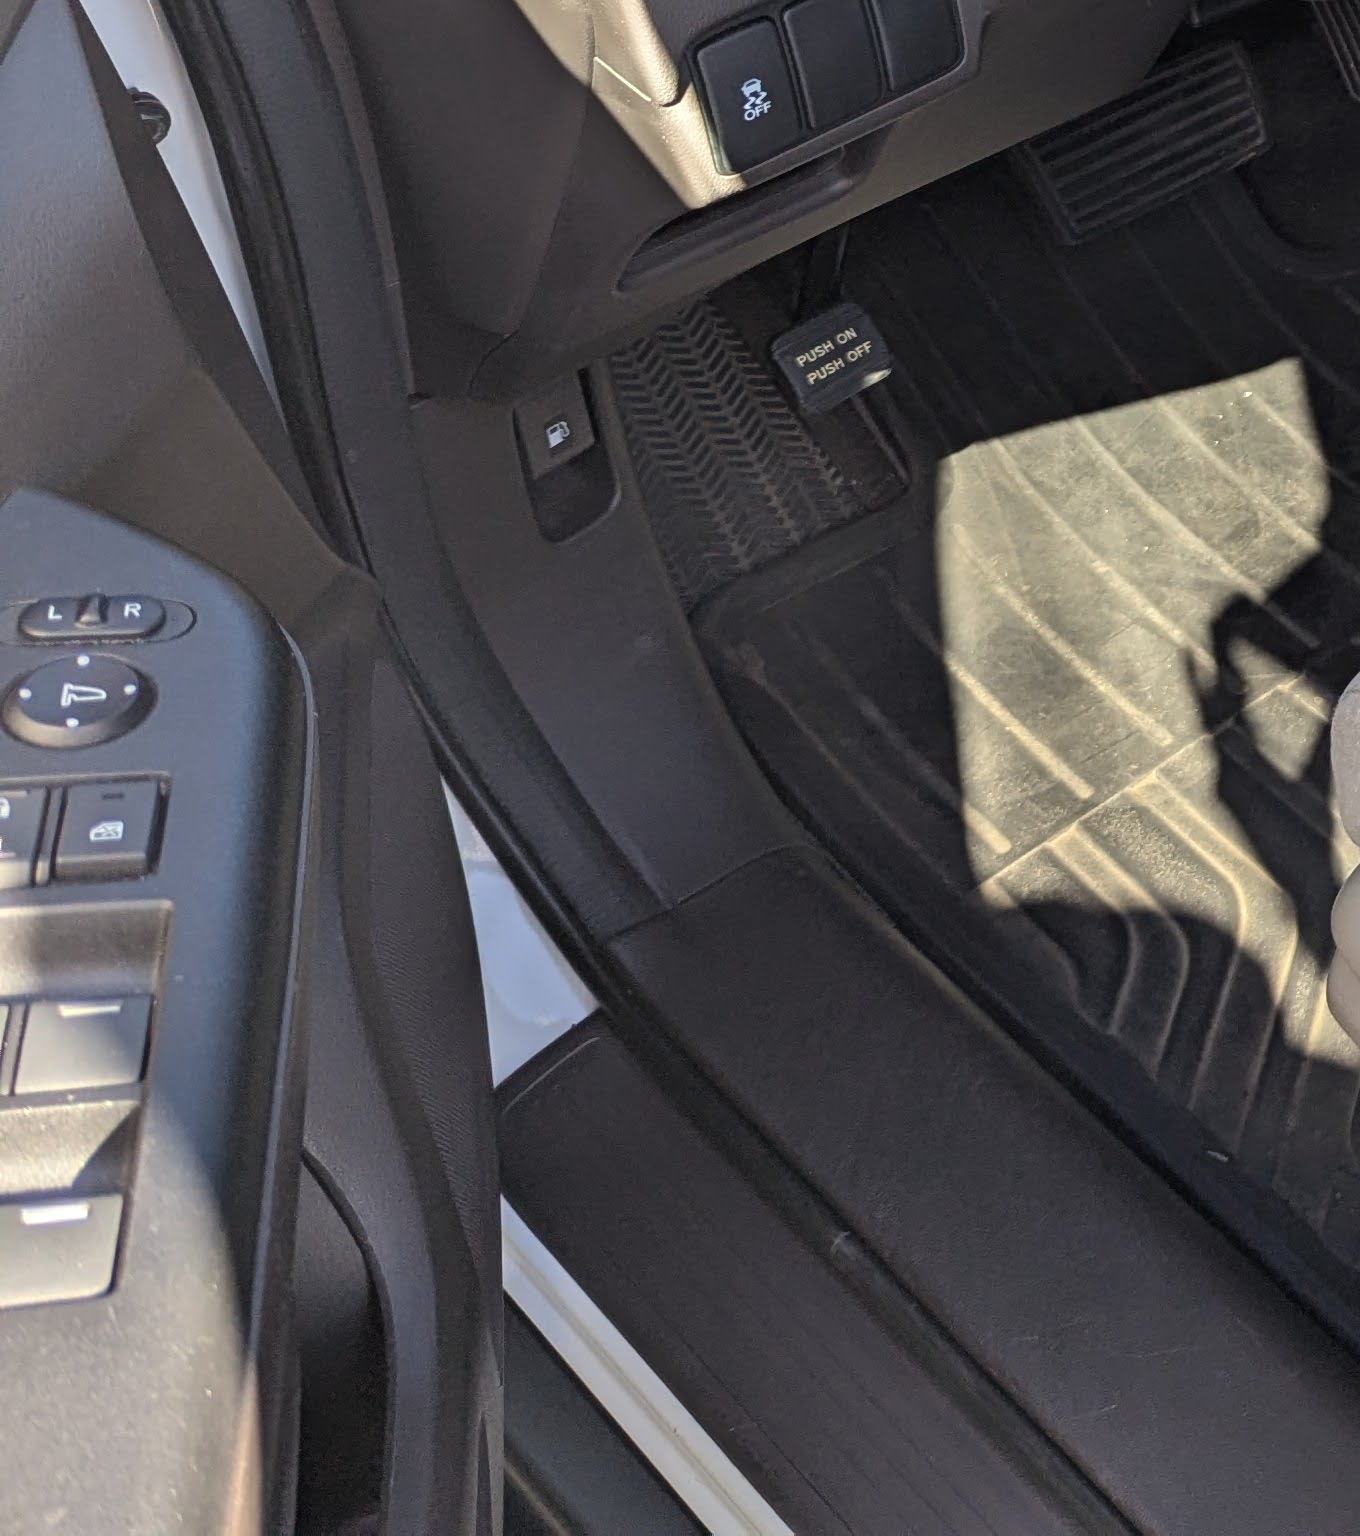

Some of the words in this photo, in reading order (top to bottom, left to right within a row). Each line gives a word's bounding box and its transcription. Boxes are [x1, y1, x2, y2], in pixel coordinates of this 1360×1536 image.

[744, 101, 771, 121] OFF
[796, 340, 835, 367] PUSH
[836, 327, 857, 344] ON
[807, 358, 845, 384] PUSH
[846, 340, 872, 362] OFF
[47, 604, 63, 621] L
[124, 603, 142, 618] R
